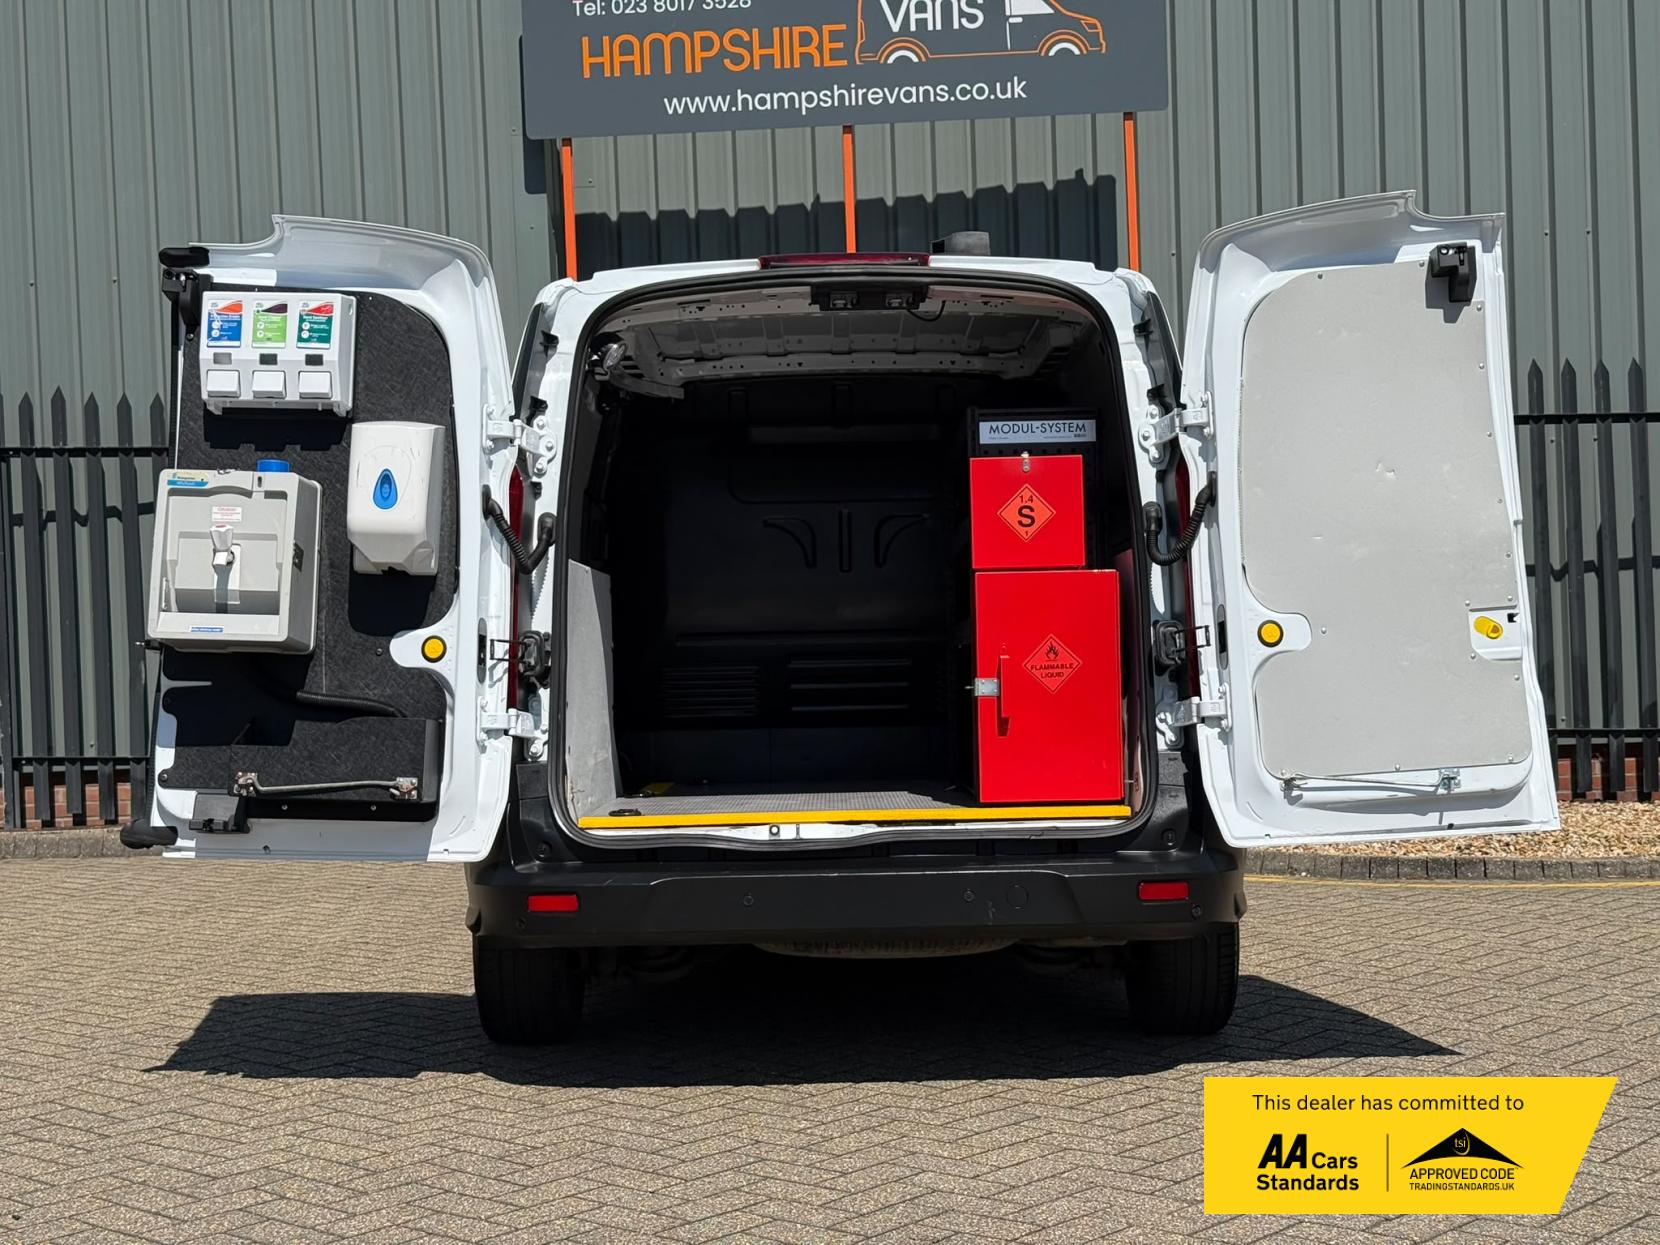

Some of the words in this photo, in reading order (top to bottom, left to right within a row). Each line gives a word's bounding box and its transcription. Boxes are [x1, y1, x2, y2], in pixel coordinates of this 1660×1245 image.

[573, 0, 606, 17] Tel:
[611, 0, 648, 15] 023
[879, 0, 985, 33] VANS
[581, 24, 848, 79] HAMPSHIRE
[663, 76, 1027, 116] www.hampshirevans.co.uk
[989, 422, 1087, 434] MODUL-SYSTEM
[1019, 494, 1034, 504] 1.4
[1017, 505, 1036, 528] S
[1030, 663, 1074, 671] FLAMMABLE
